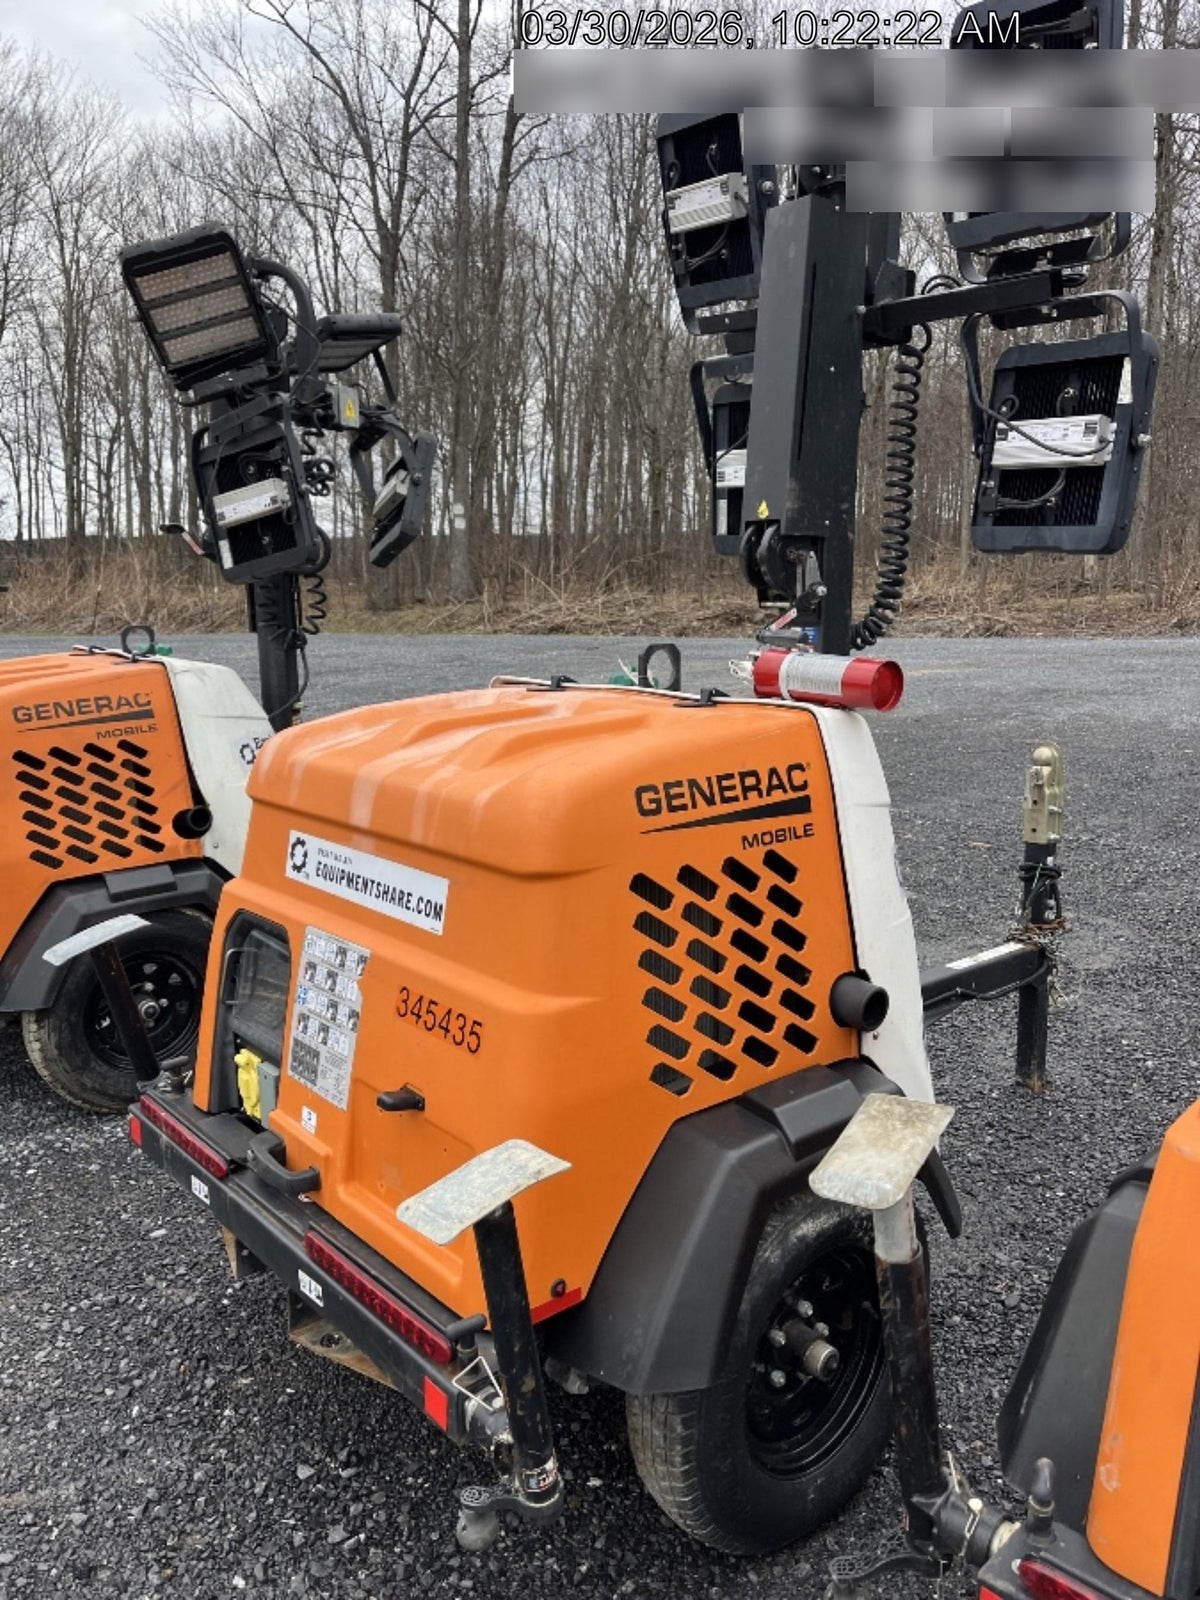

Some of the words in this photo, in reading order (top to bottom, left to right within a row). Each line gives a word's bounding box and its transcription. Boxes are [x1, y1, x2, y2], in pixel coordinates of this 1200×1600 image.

[12, 692, 152, 723] GENERAC
[96, 723, 157, 739] MOBILE
[635, 762, 808, 817] GENERAC
[741, 823, 815, 850] MOBILE
[315, 861, 444, 922] EQUIPMENTSHARE.COM
[396, 986, 483, 1054] 345435
